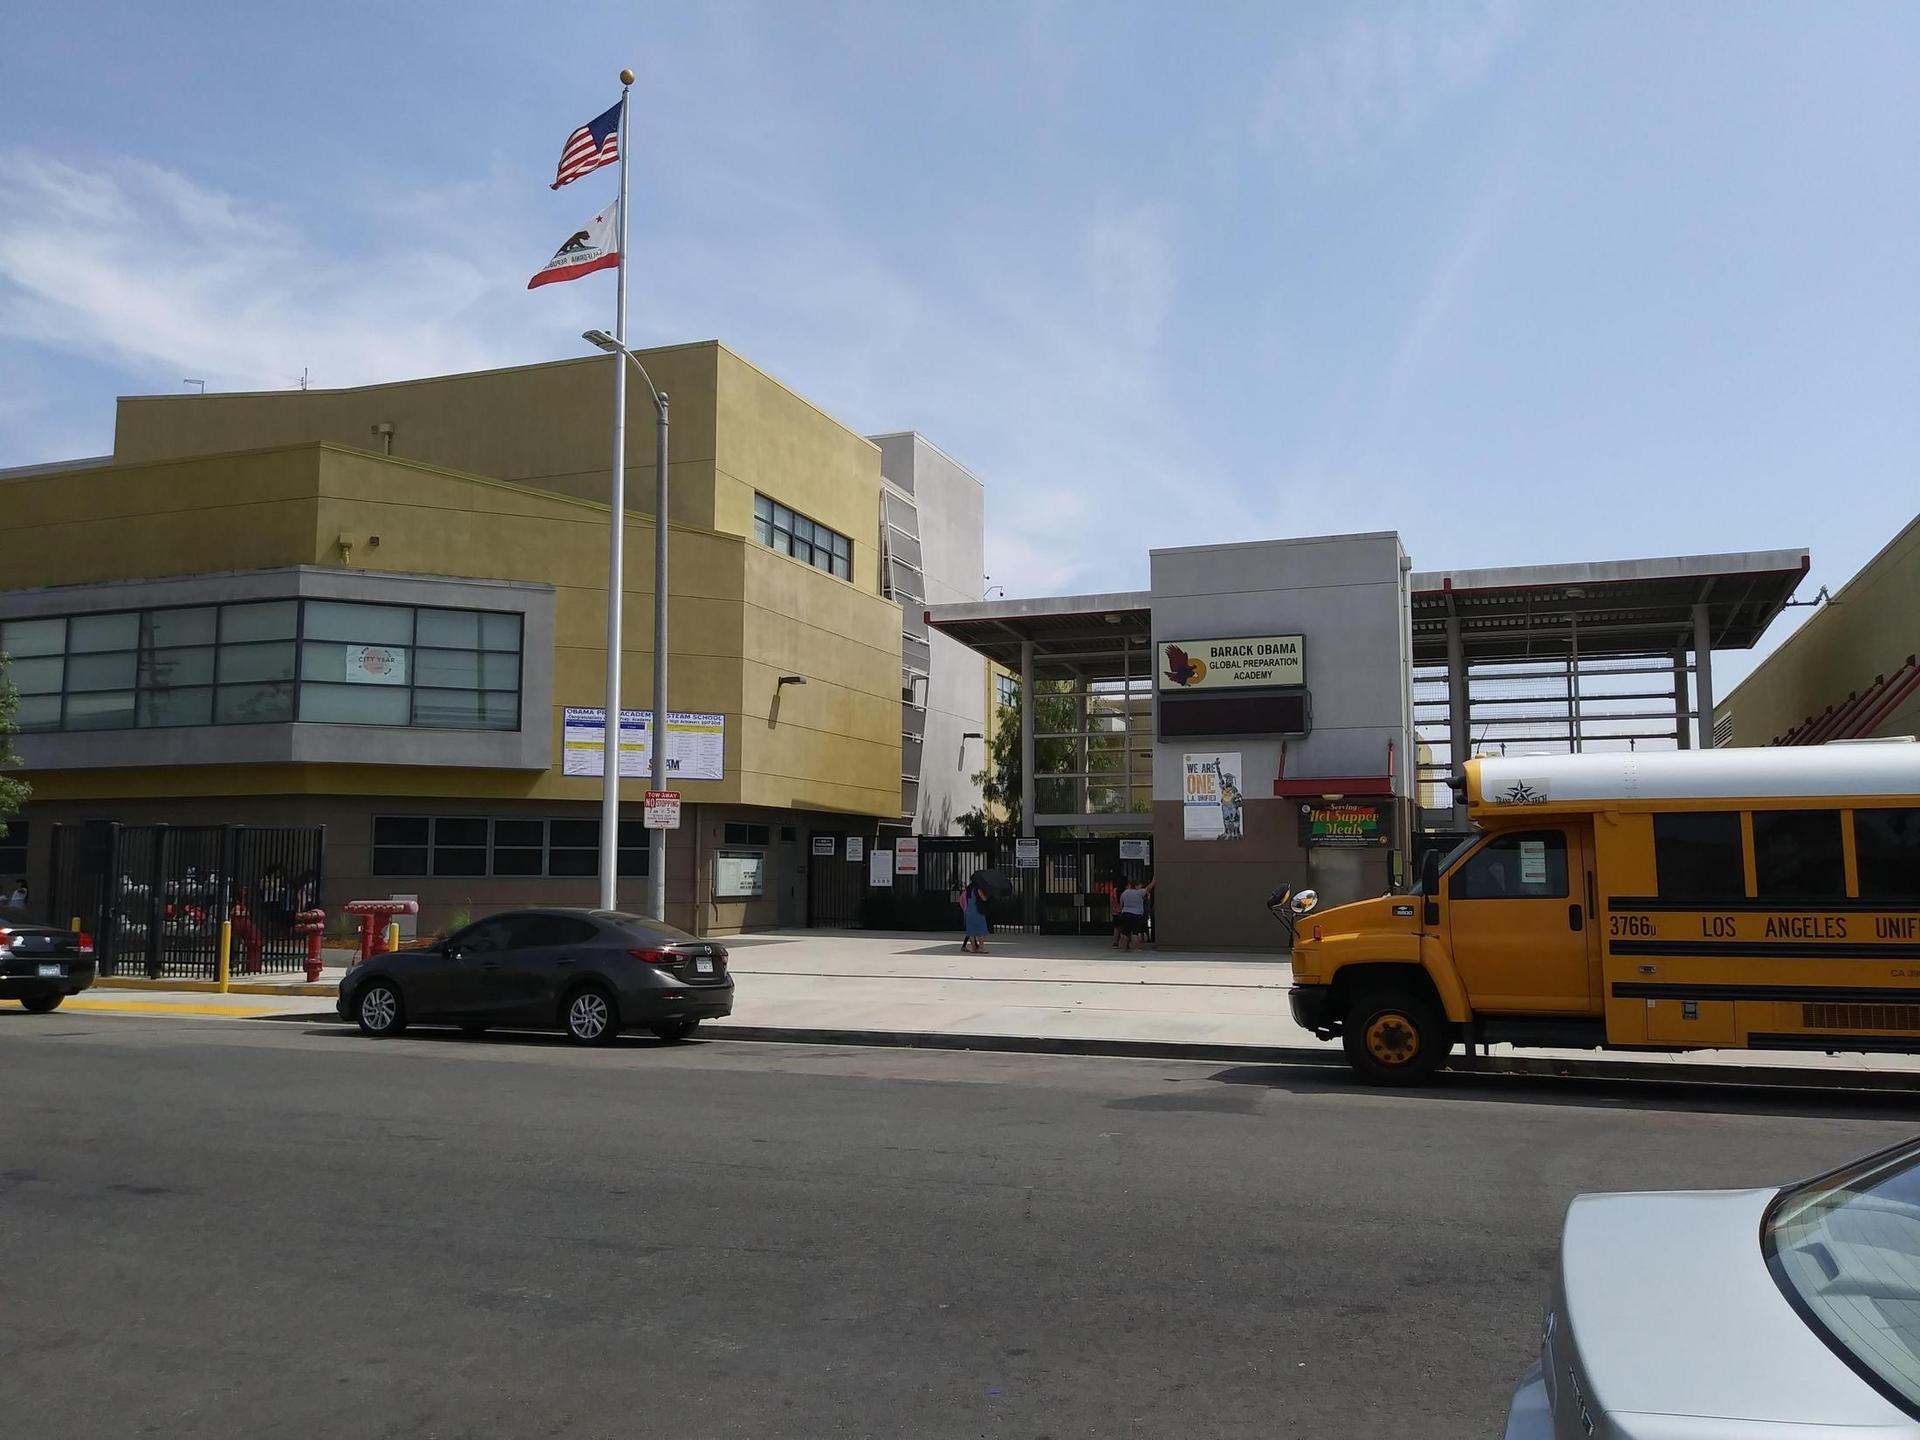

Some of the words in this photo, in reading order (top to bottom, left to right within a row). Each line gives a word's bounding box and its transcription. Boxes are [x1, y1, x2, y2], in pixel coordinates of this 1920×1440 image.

[1210, 645, 1254, 658] BARACK
[1257, 643, 1297, 656] OBAMA
[1209, 660, 1241, 670] GLOBAL
[1243, 657, 1298, 668] PREPARATION
[1233, 670, 1273, 681] ACADEMY
[1187, 763, 1199, 774] WE
[1202, 763, 1216, 774] ARE
[1187, 774, 1217, 794] ONE
[645, 798, 655, 807] NO
[1331, 803, 1358, 811] Serving
[1310, 810, 1331, 822] Hot
[1333, 810, 1380, 824] Supper
[1326, 823, 1363, 836] Meals
[1702, 916, 1736, 938] LOS
[1765, 917, 1847, 939] ANGELES
[1875, 917, 1920, 939] UNIF
